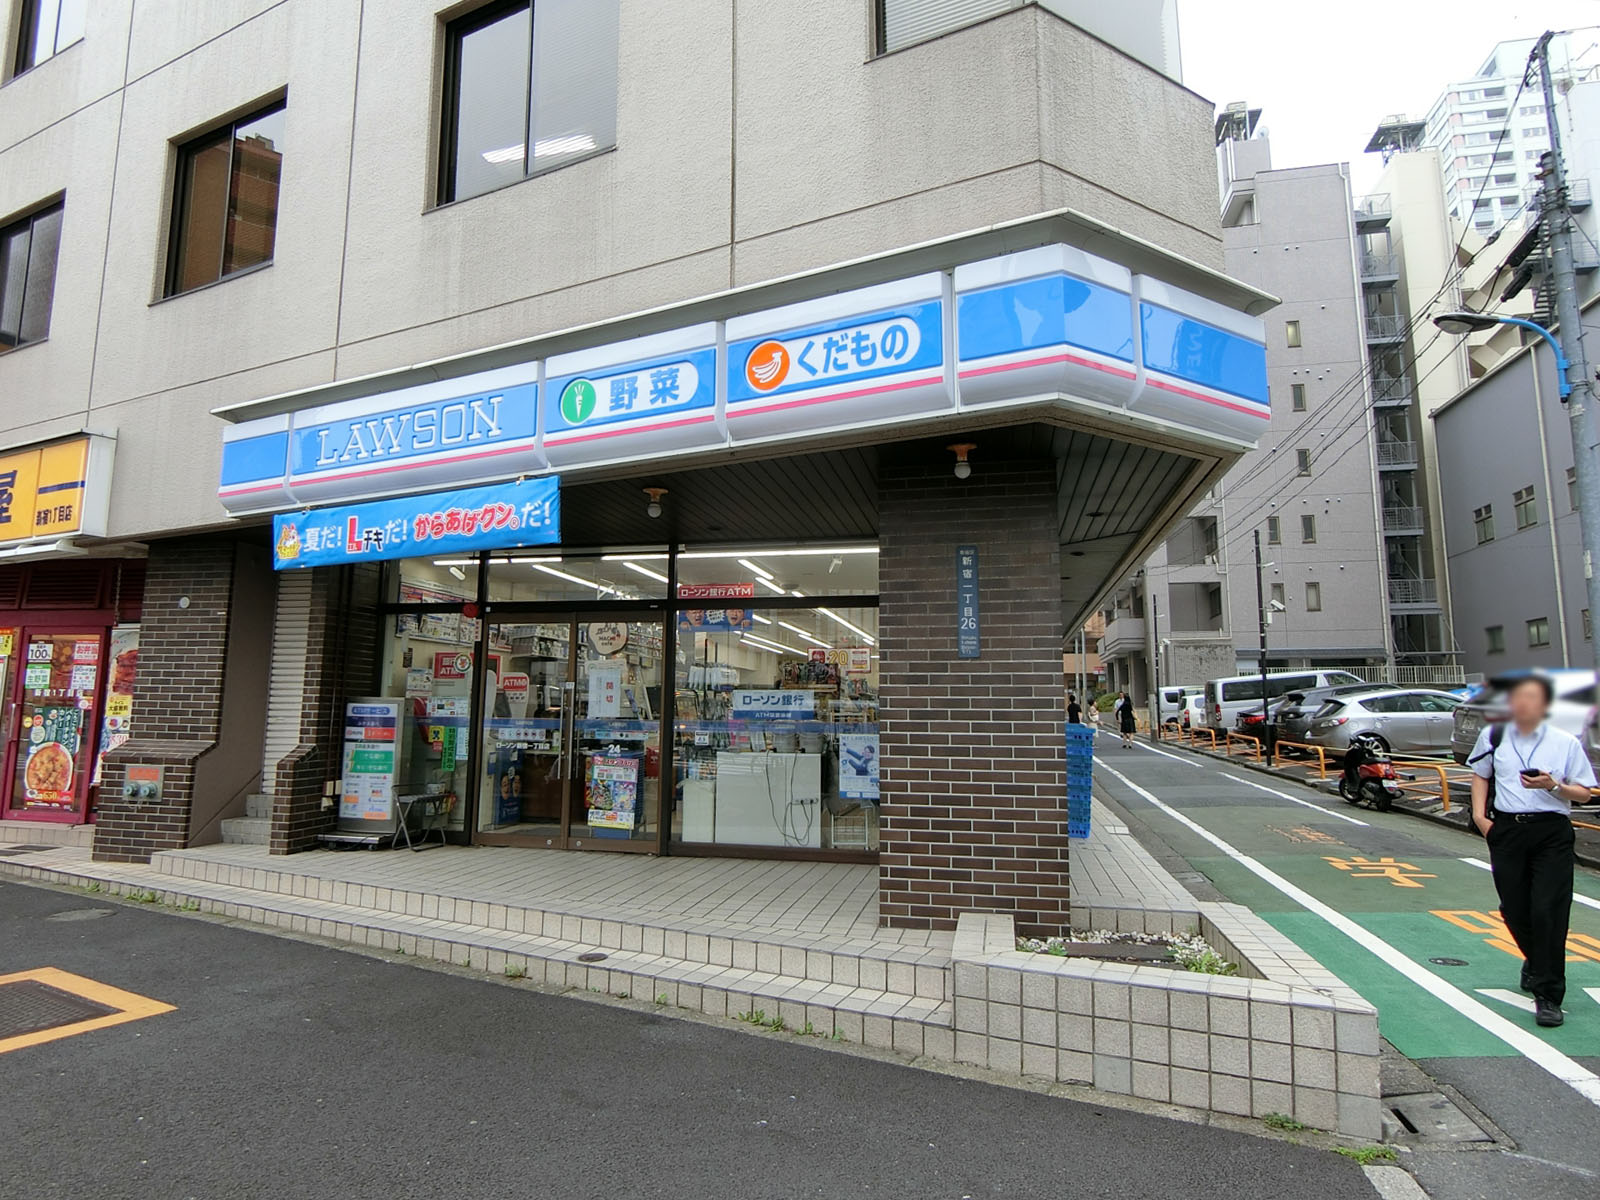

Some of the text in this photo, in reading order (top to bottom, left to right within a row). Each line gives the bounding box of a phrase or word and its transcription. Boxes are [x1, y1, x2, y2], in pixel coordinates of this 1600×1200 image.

[797, 324, 909, 377] くだもの
[608, 361, 681, 413] 野菜
[316, 396, 504, 467] LAWSON
[681, 587, 752, 597] ローソン銀行ATM
[961, 617, 977, 630] 26
[742, 694, 805, 706] ローソン銀行
[608, 744, 621, 754] 24
